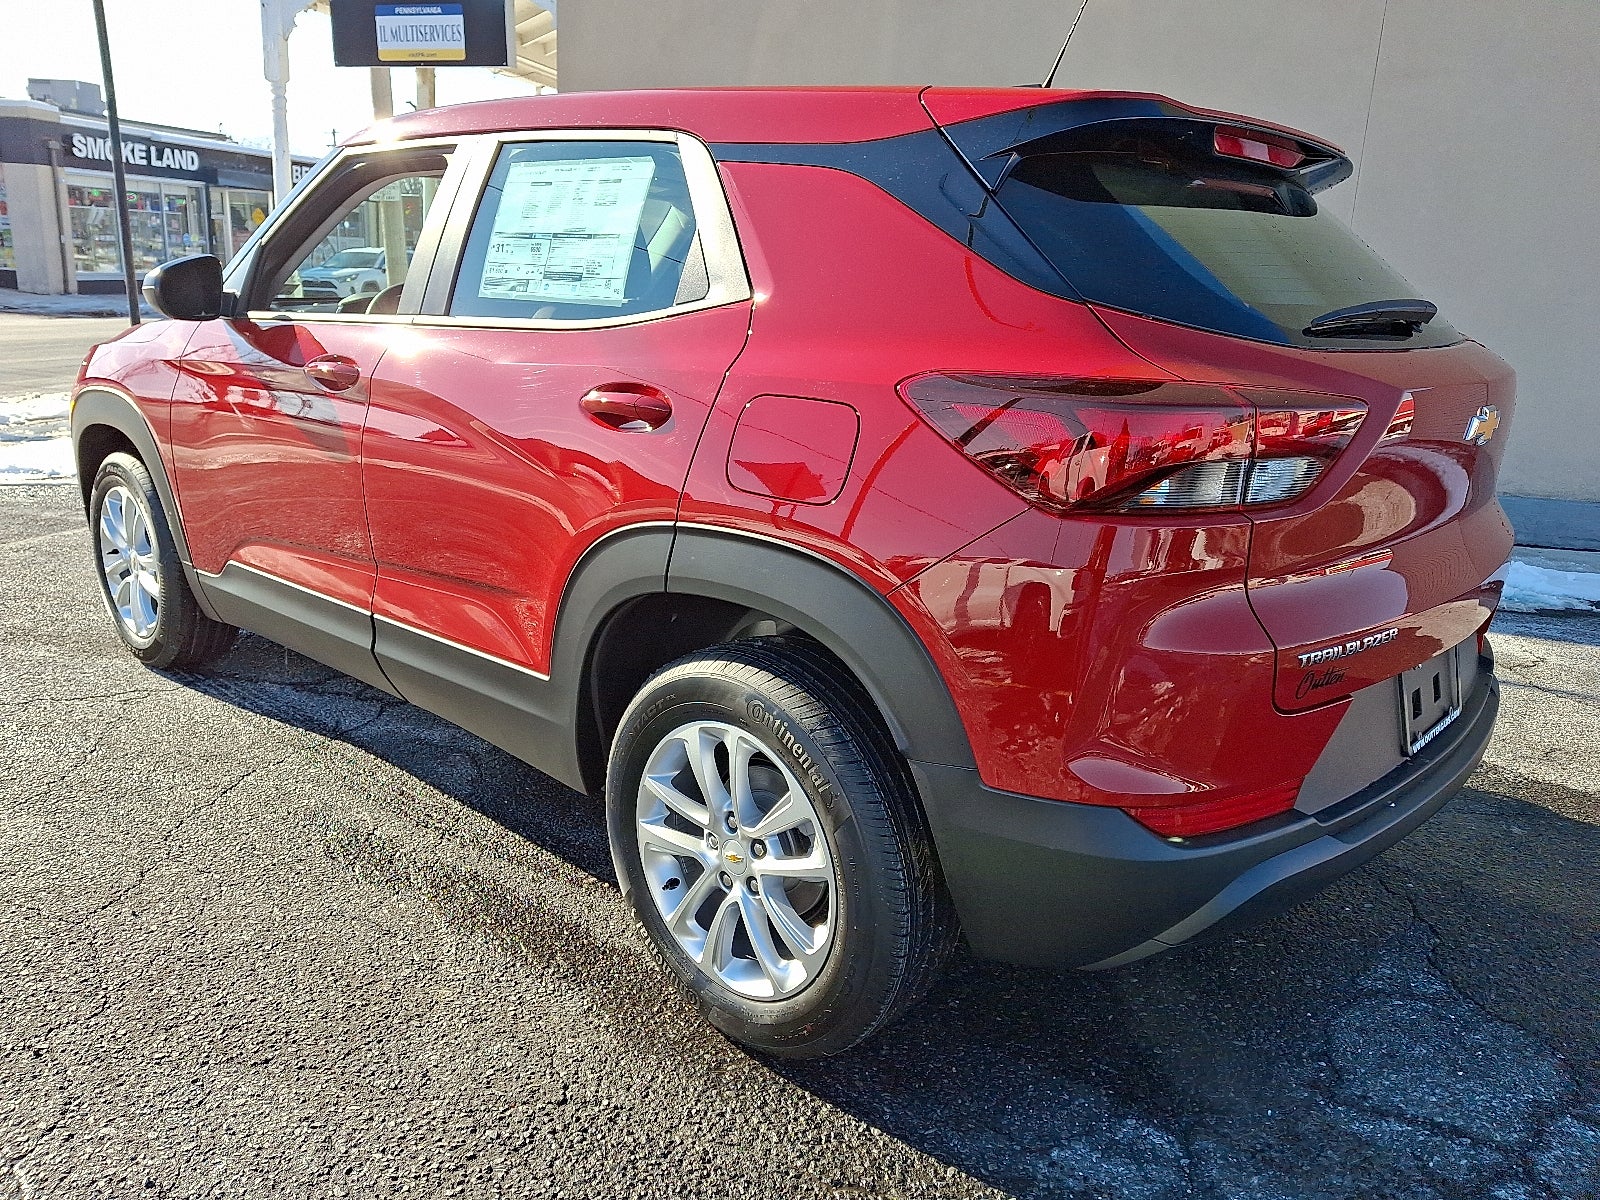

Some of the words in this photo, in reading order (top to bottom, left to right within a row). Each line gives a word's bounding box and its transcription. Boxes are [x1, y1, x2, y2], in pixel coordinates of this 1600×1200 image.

[394, 6, 442, 14] PENNSYLVANIA
[390, 24, 462, 42] MULTISERVICES
[150, 145, 199, 171] LAND
[1298, 627, 1399, 668] TRAILBLAZER
[746, 699, 832, 795] Continental
